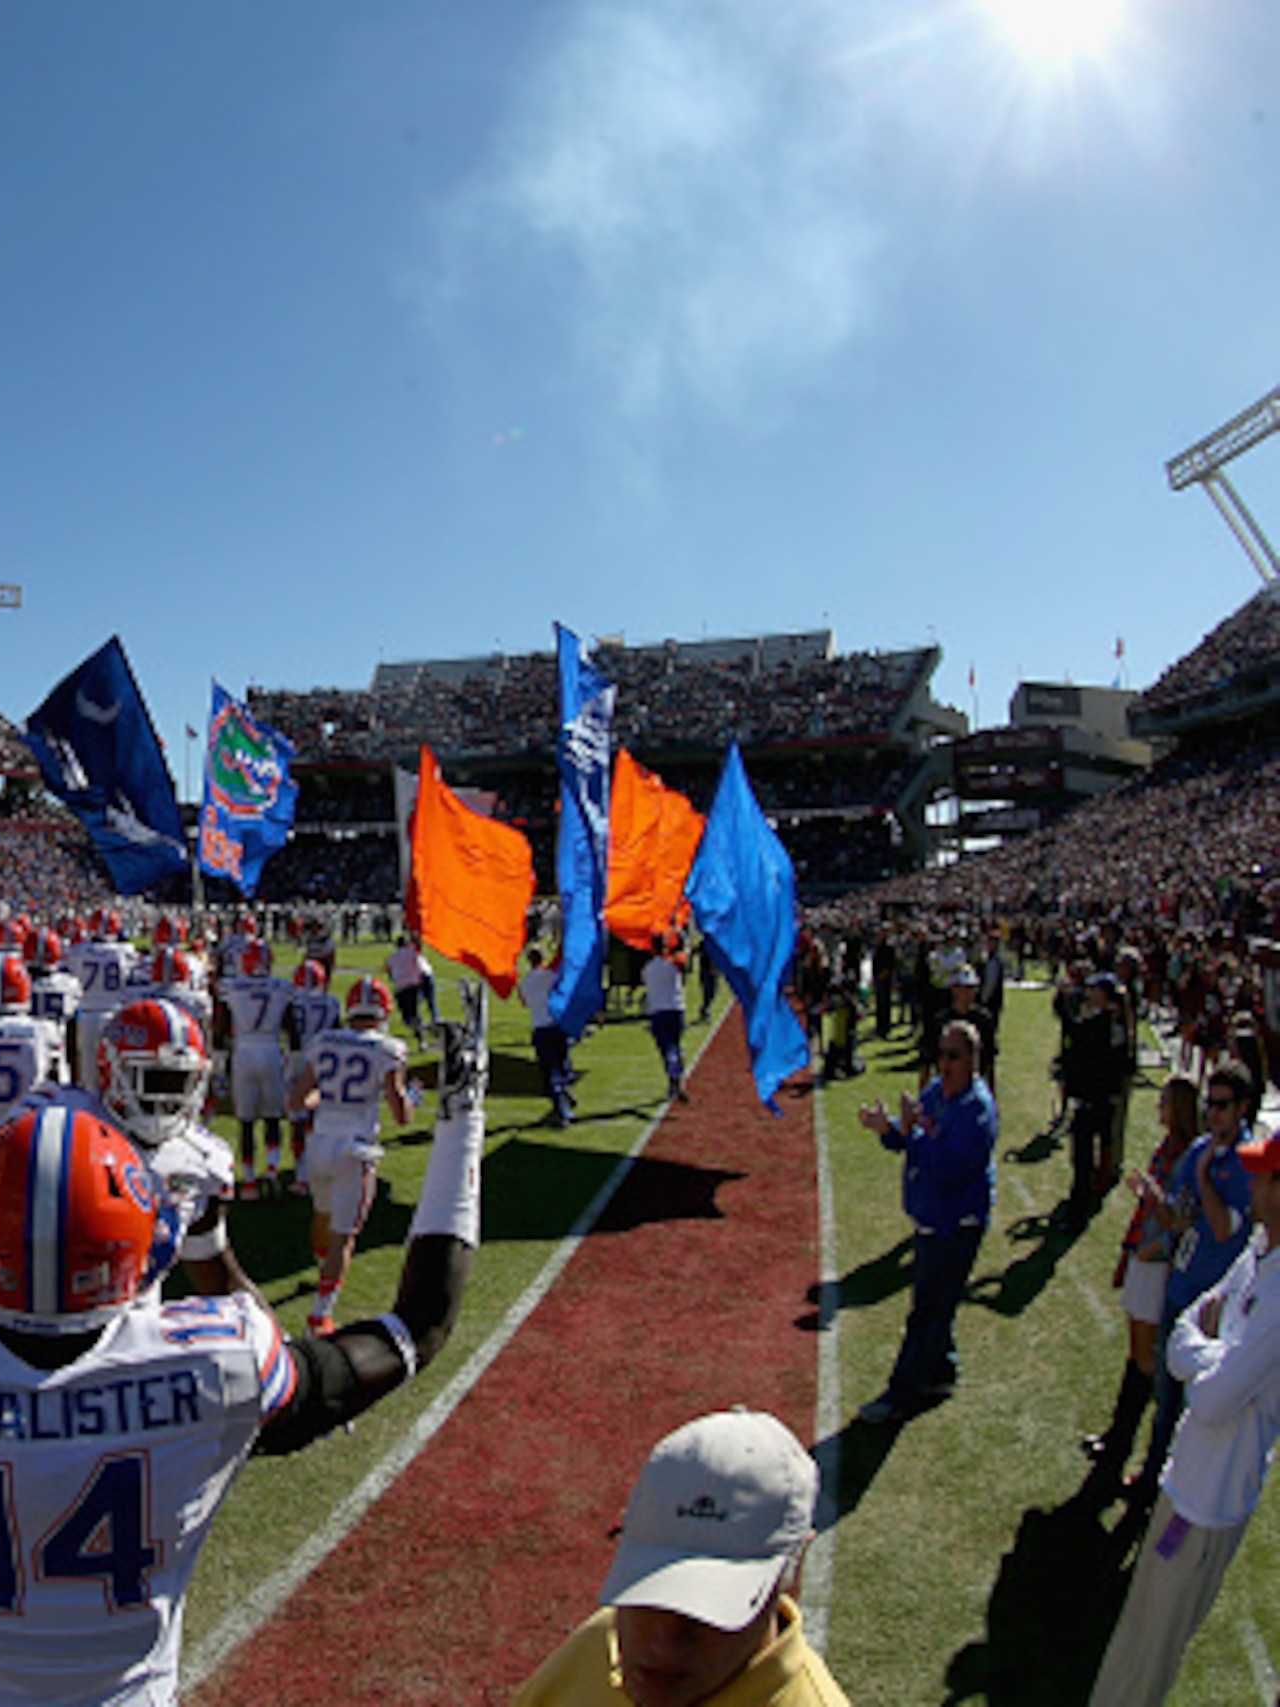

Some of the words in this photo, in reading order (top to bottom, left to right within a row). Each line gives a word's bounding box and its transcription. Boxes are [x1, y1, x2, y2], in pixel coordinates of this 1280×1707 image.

[81, 961, 121, 992] 78
[249, 992, 271, 1031] 7
[317, 1050, 371, 1104] 22
